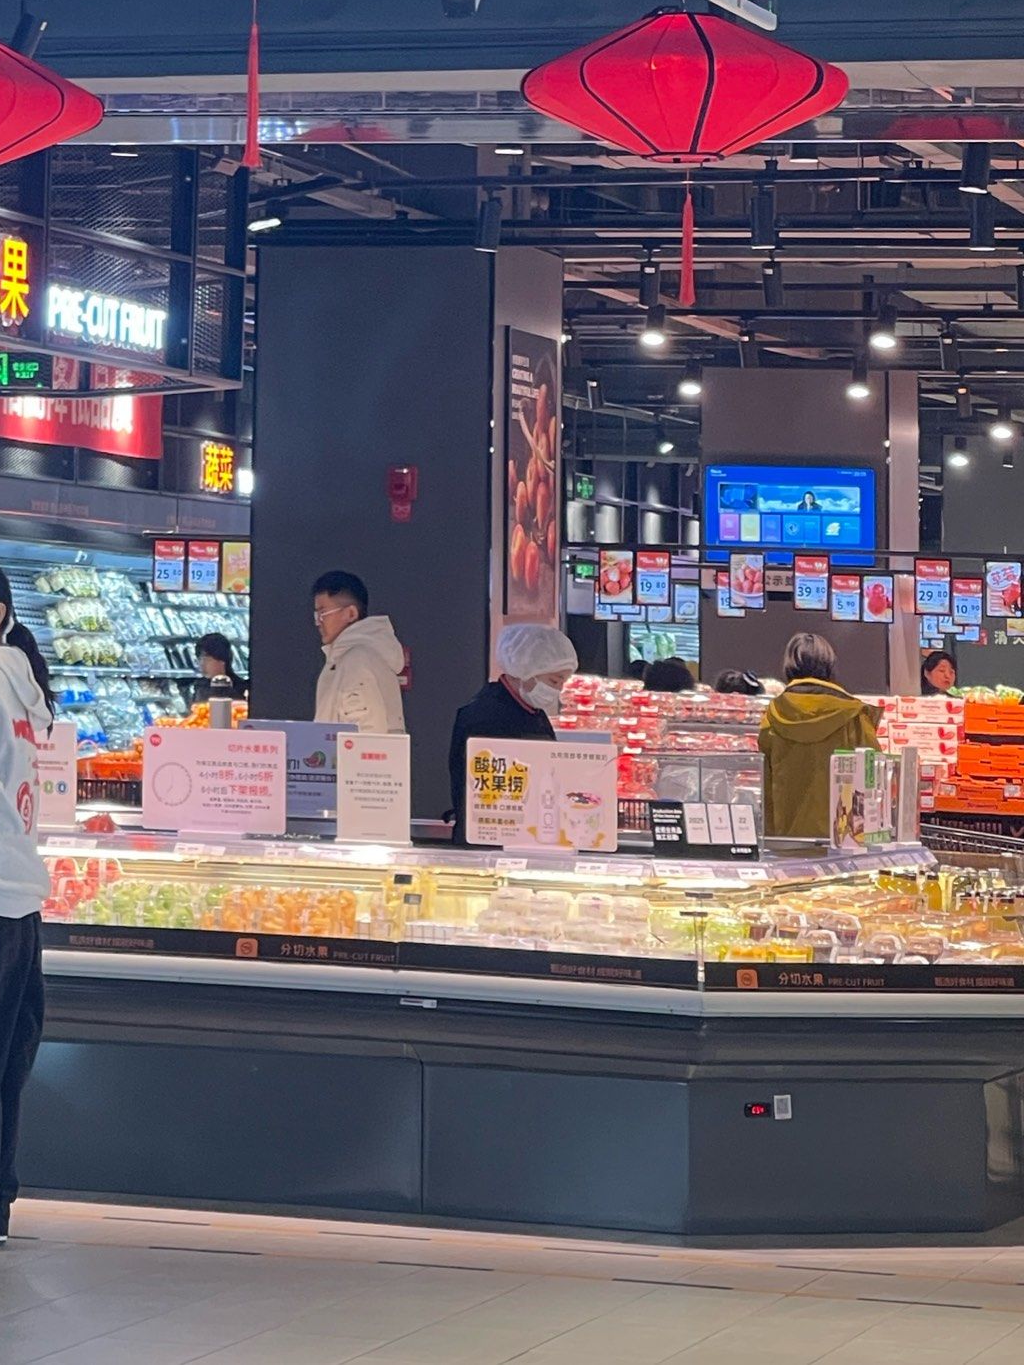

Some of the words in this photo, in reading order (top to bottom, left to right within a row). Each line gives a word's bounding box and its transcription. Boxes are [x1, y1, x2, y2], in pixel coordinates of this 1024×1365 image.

[48, 285, 119, 340] PRE-CUT
[120, 301, 168, 350] FRUIT
[157, 569, 170, 580] 25
[191, 570, 203, 580] 19
[640, 581, 653, 592] 19
[797, 586, 812, 597] 39
[919, 590, 933, 601] 29
[837, 600, 844, 610] 5
[956, 604, 968, 614] 10
[474, 755, 507, 775] 酸奶
[474, 775, 524, 793] 水果捞
[280, 943, 329, 958] 分切水果
[778, 971, 825, 986] 分切水果
